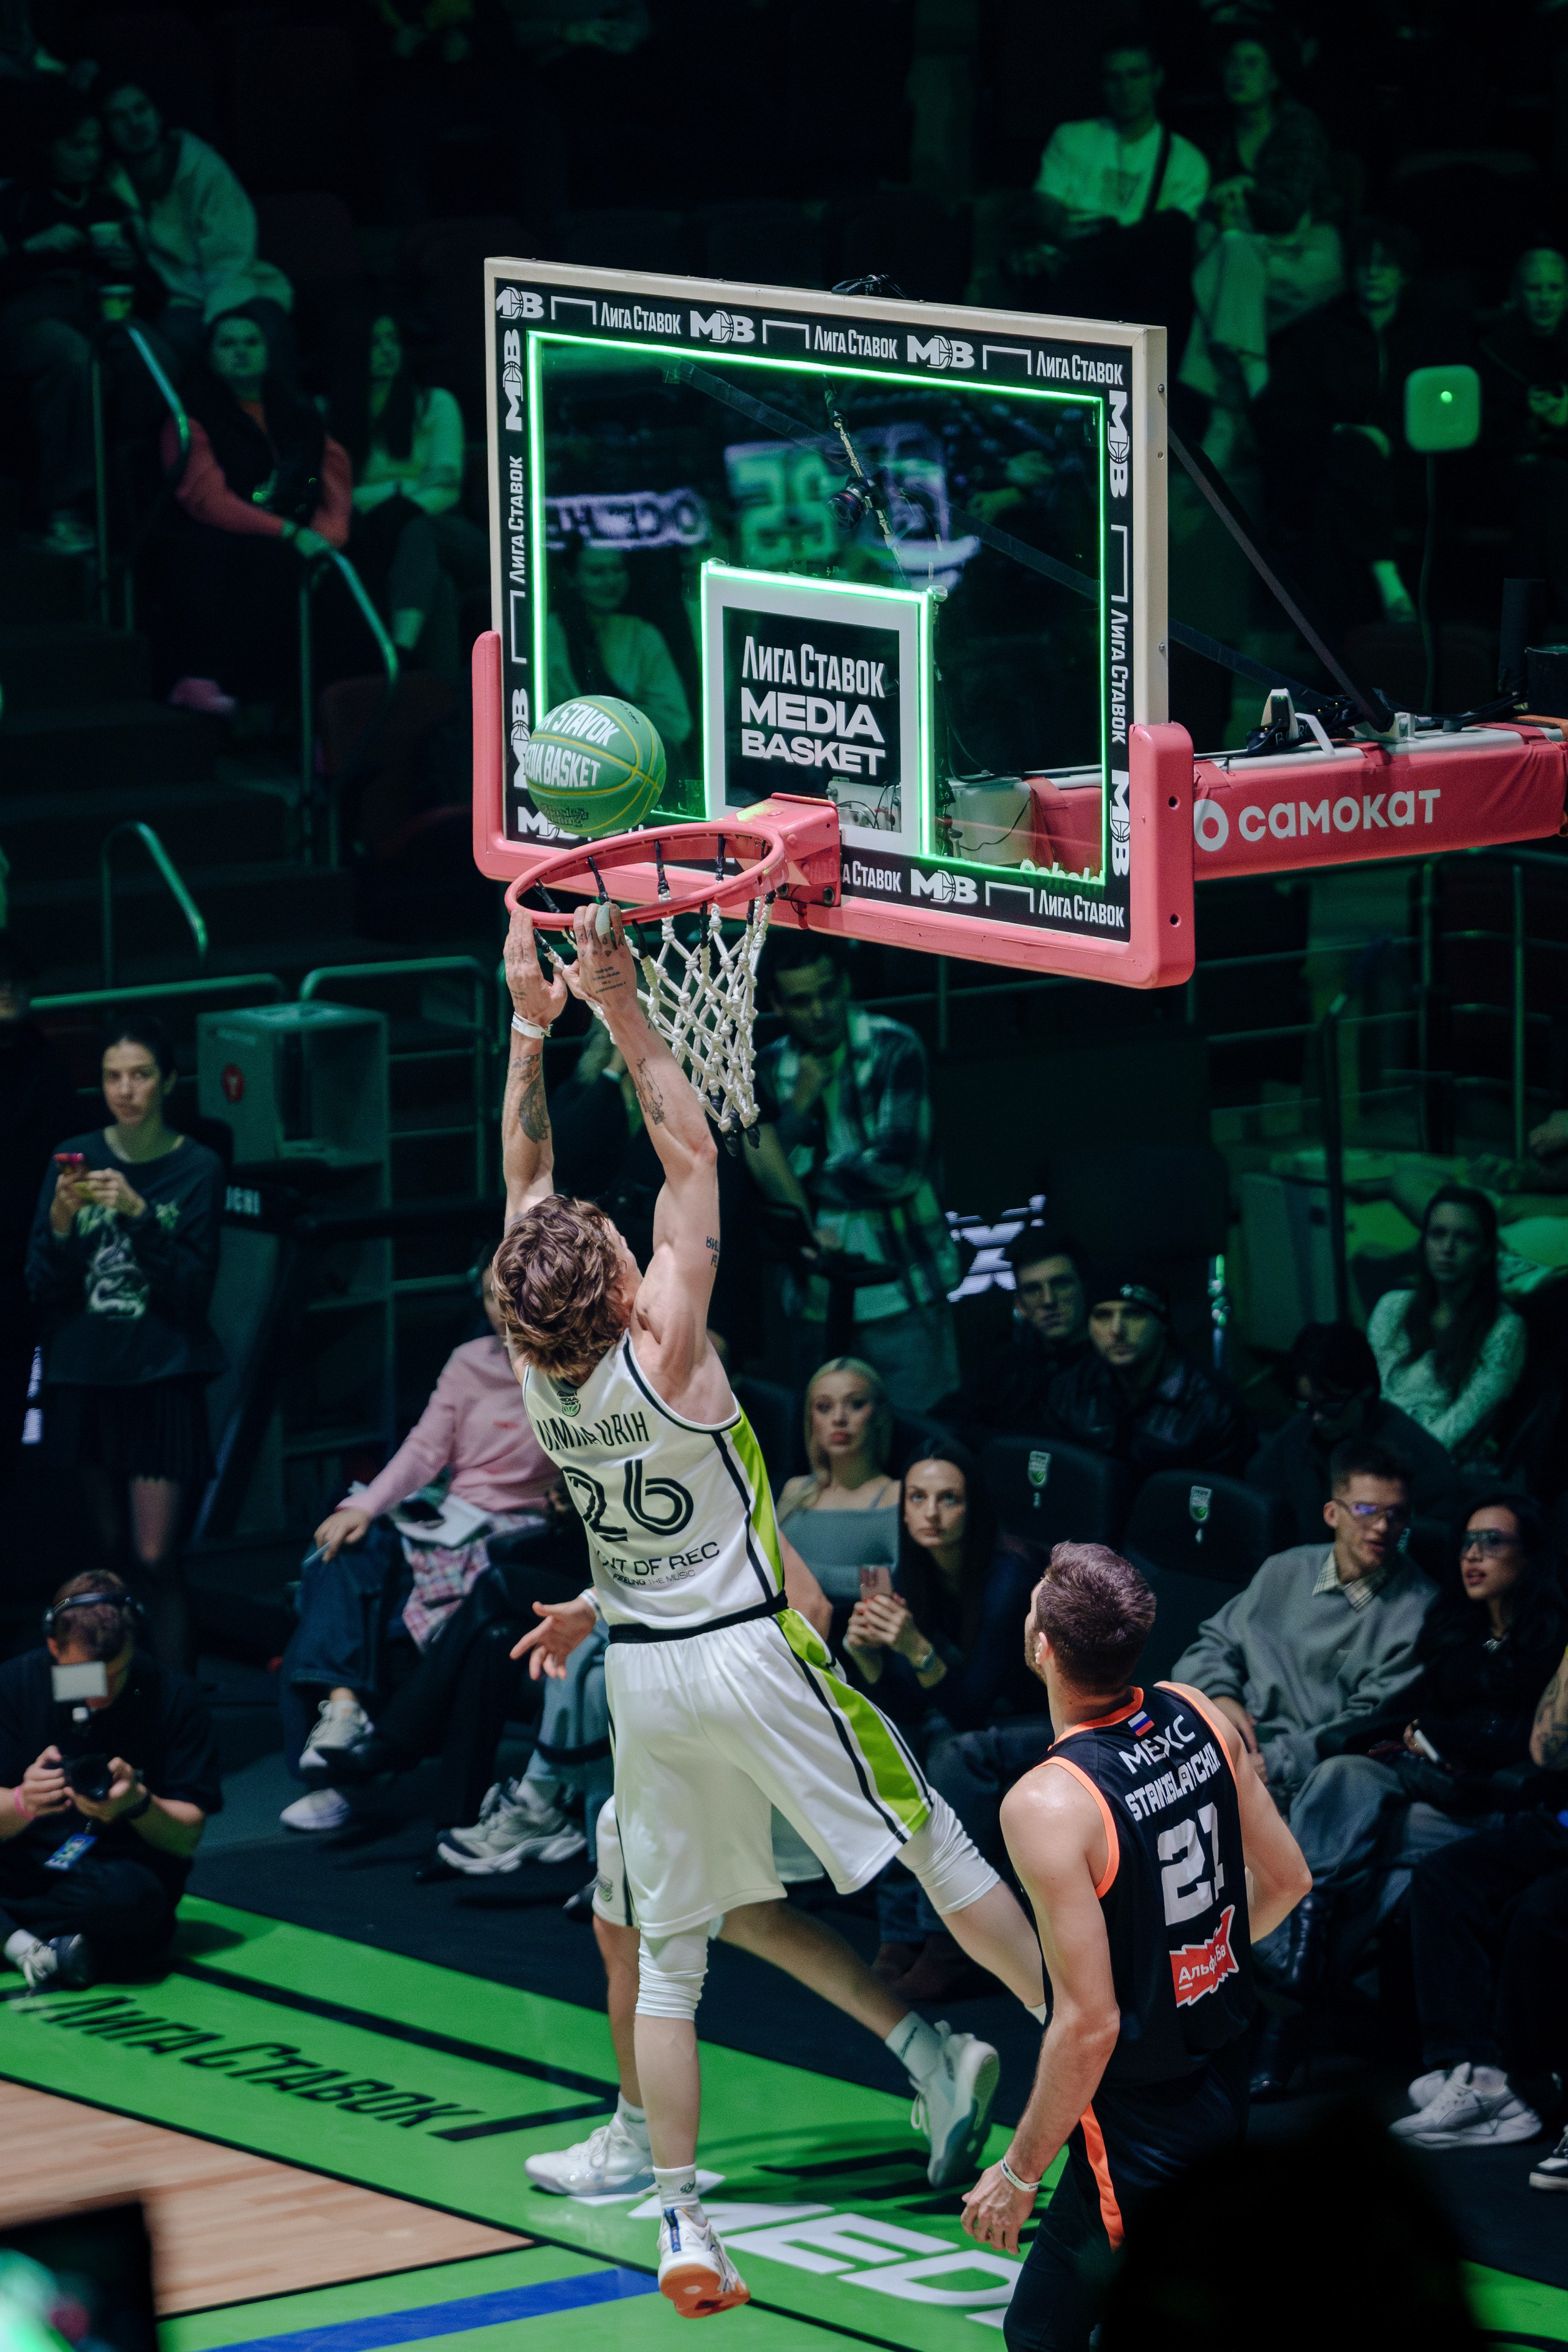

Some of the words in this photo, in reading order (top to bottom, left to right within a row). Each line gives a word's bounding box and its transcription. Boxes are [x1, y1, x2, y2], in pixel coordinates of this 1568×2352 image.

[552, 703, 620, 747] STAVOK
[741, 687, 885, 743] MEDIA
[544, 745, 601, 788] BASKET
[742, 728, 886, 775] BASKET
[1238, 789, 1441, 842] самокат
[561, 1458, 695, 1542] 26
[613, 1573, 646, 1585] FEELING
[648, 1577, 665, 1585] THE
[666, 1569, 696, 1583] MUSIC
[634, 1558, 662, 1575] OF
[669, 1541, 720, 1570] REC
[1158, 1802, 1225, 1926] 21
